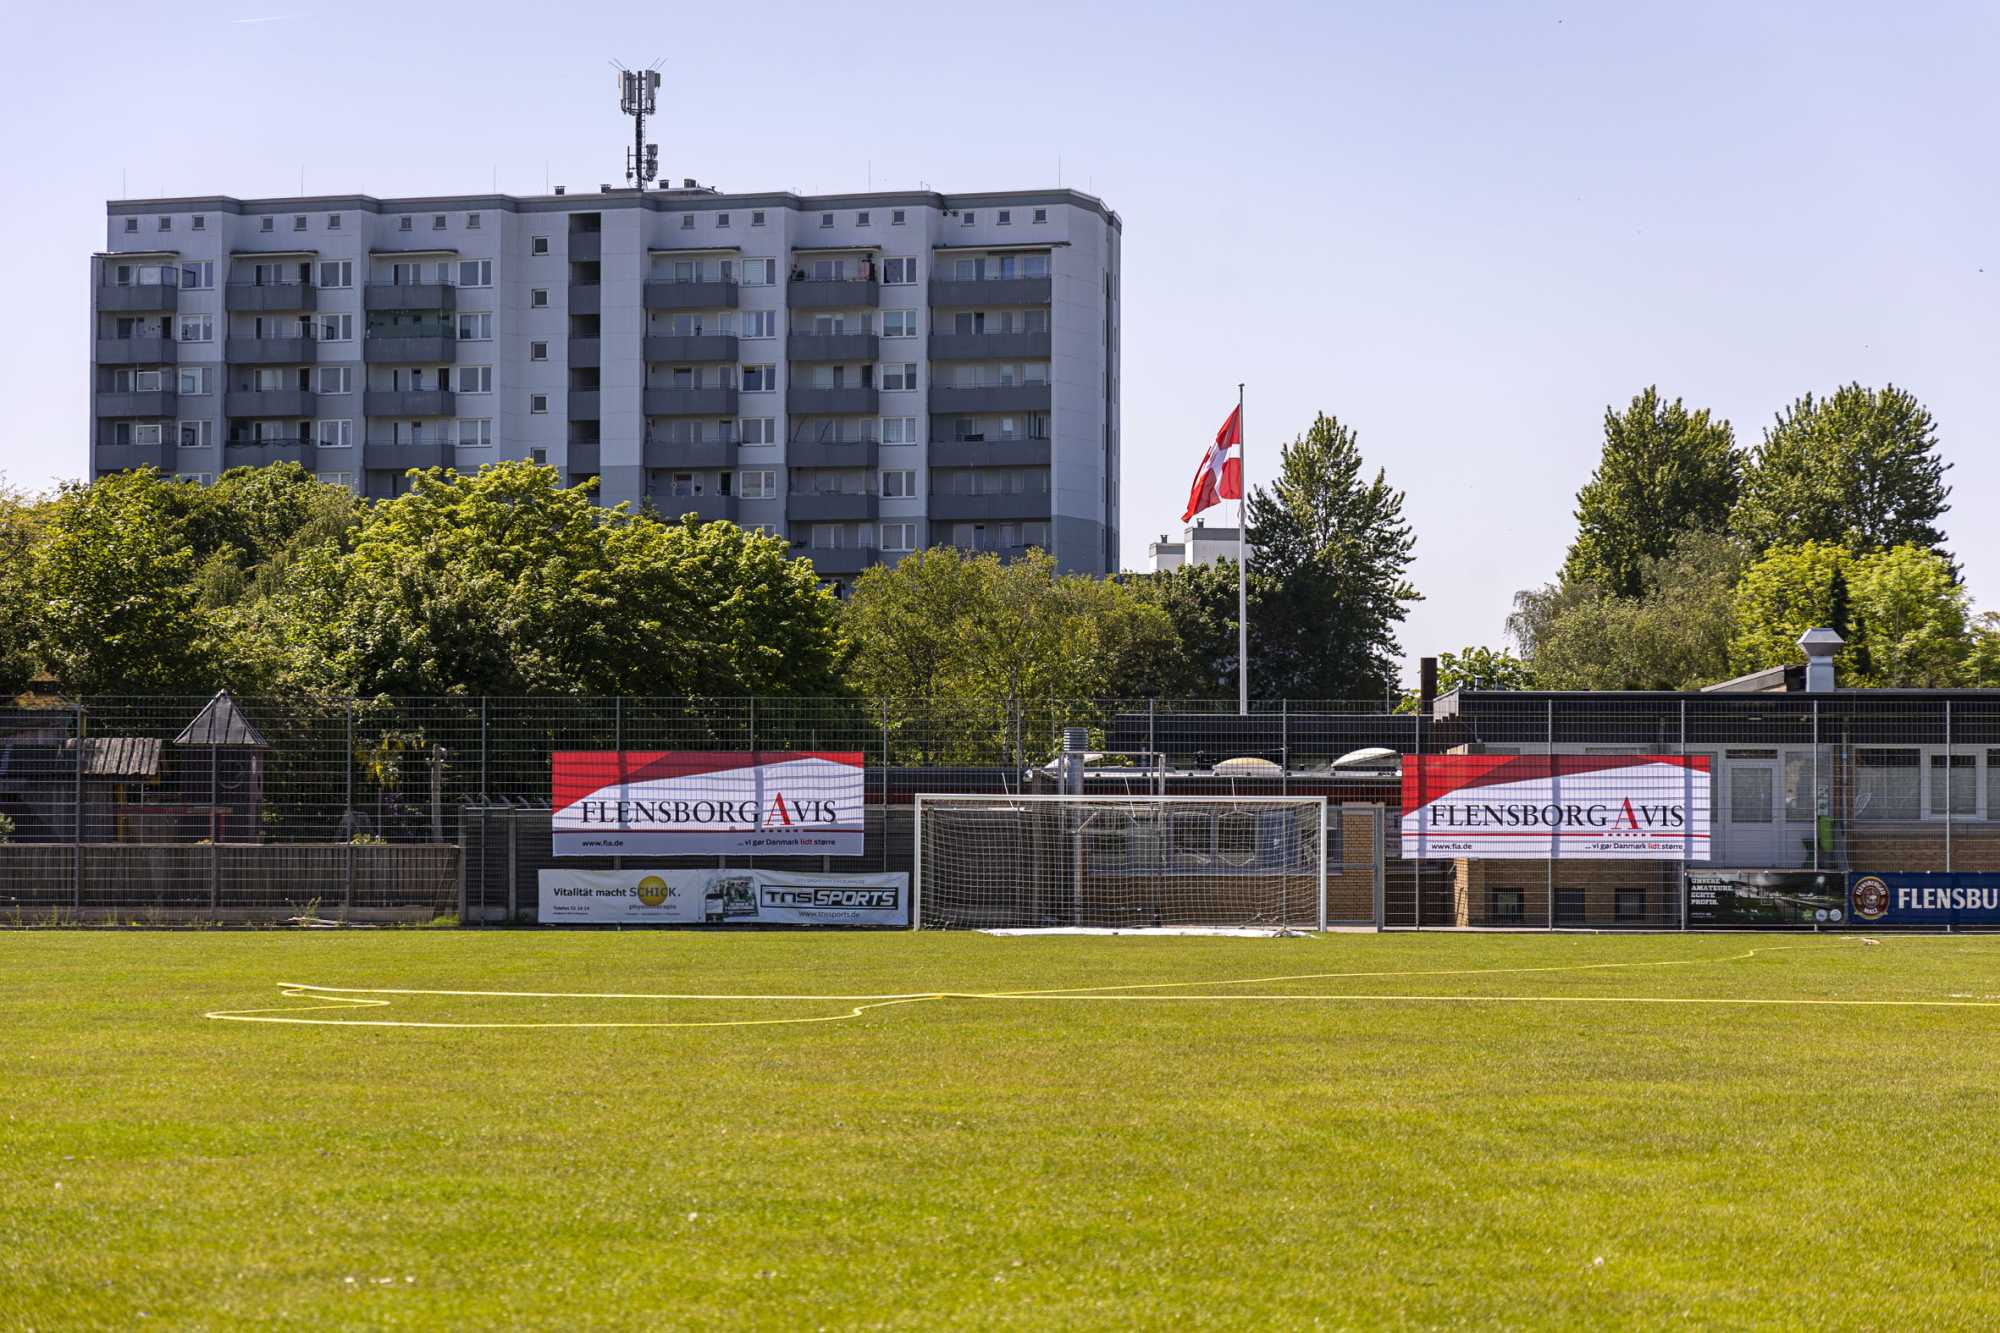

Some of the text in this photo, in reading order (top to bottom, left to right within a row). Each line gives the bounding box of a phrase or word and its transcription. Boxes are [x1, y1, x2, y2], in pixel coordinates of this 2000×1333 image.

[581, 792, 836, 826] FLENSBORG AVIS
[1430, 796, 1684, 830] FLENSBORG AVIS
[766, 838, 799, 846] Danmark
[553, 887, 593, 897] Vitalität
[595, 887, 626, 897] macht
[815, 890, 896, 906] SPORTS
